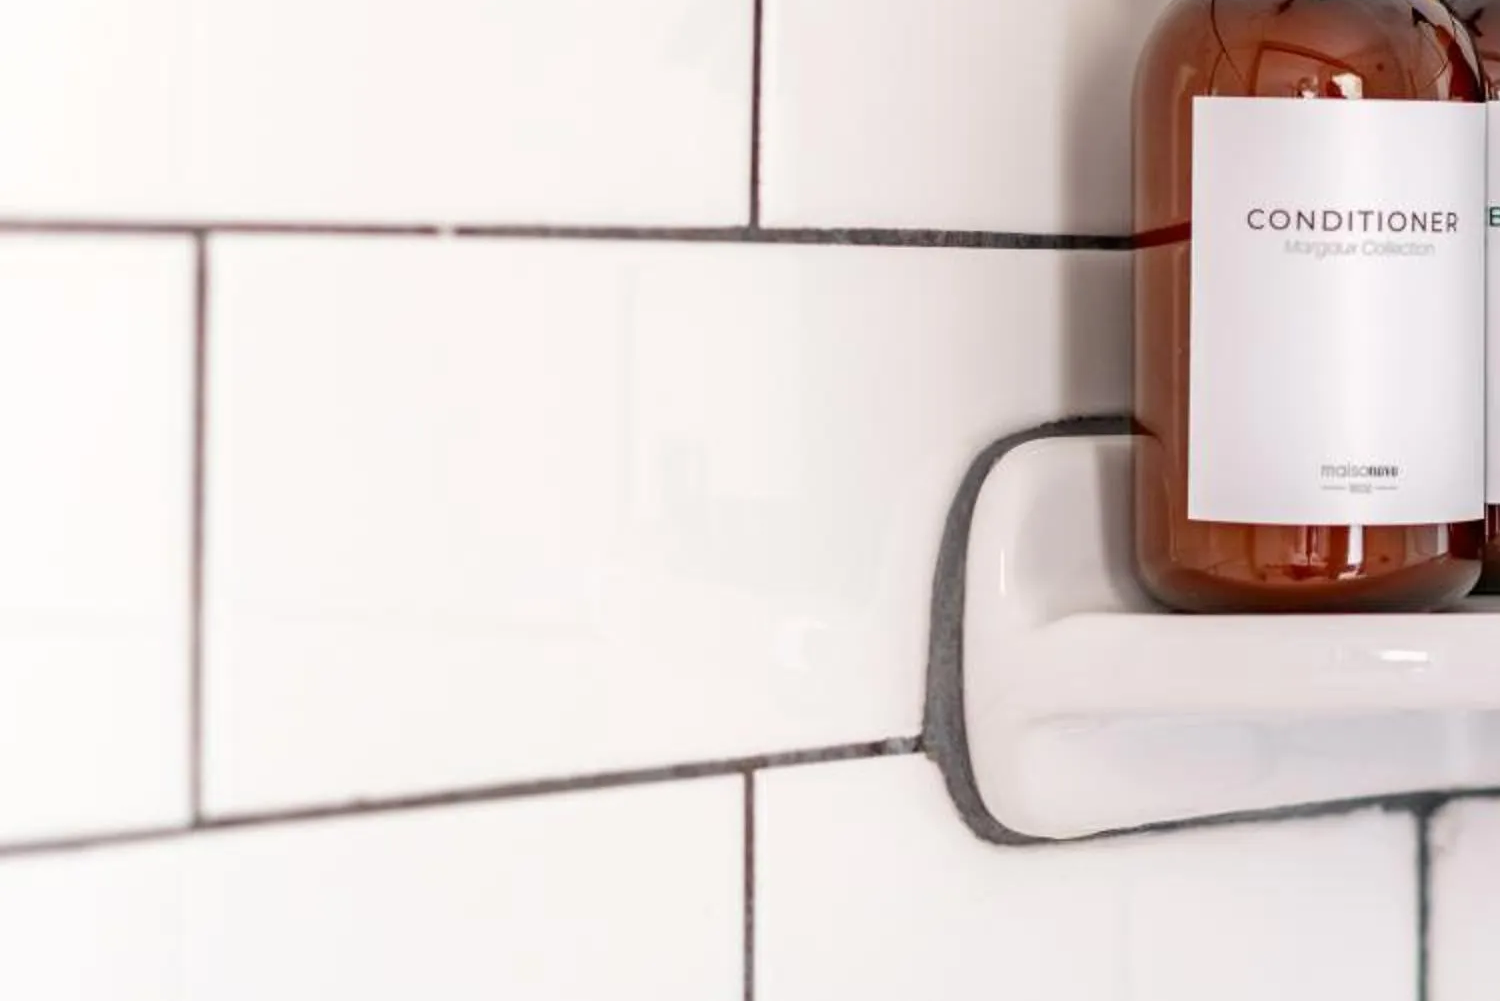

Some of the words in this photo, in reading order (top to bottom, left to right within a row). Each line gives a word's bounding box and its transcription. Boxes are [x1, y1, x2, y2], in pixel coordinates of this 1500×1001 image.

[1247, 208, 1458, 233] CONDITIONER
[1284, 238, 1358, 259] Margaux
[1362, 239, 1436, 256] Collection
